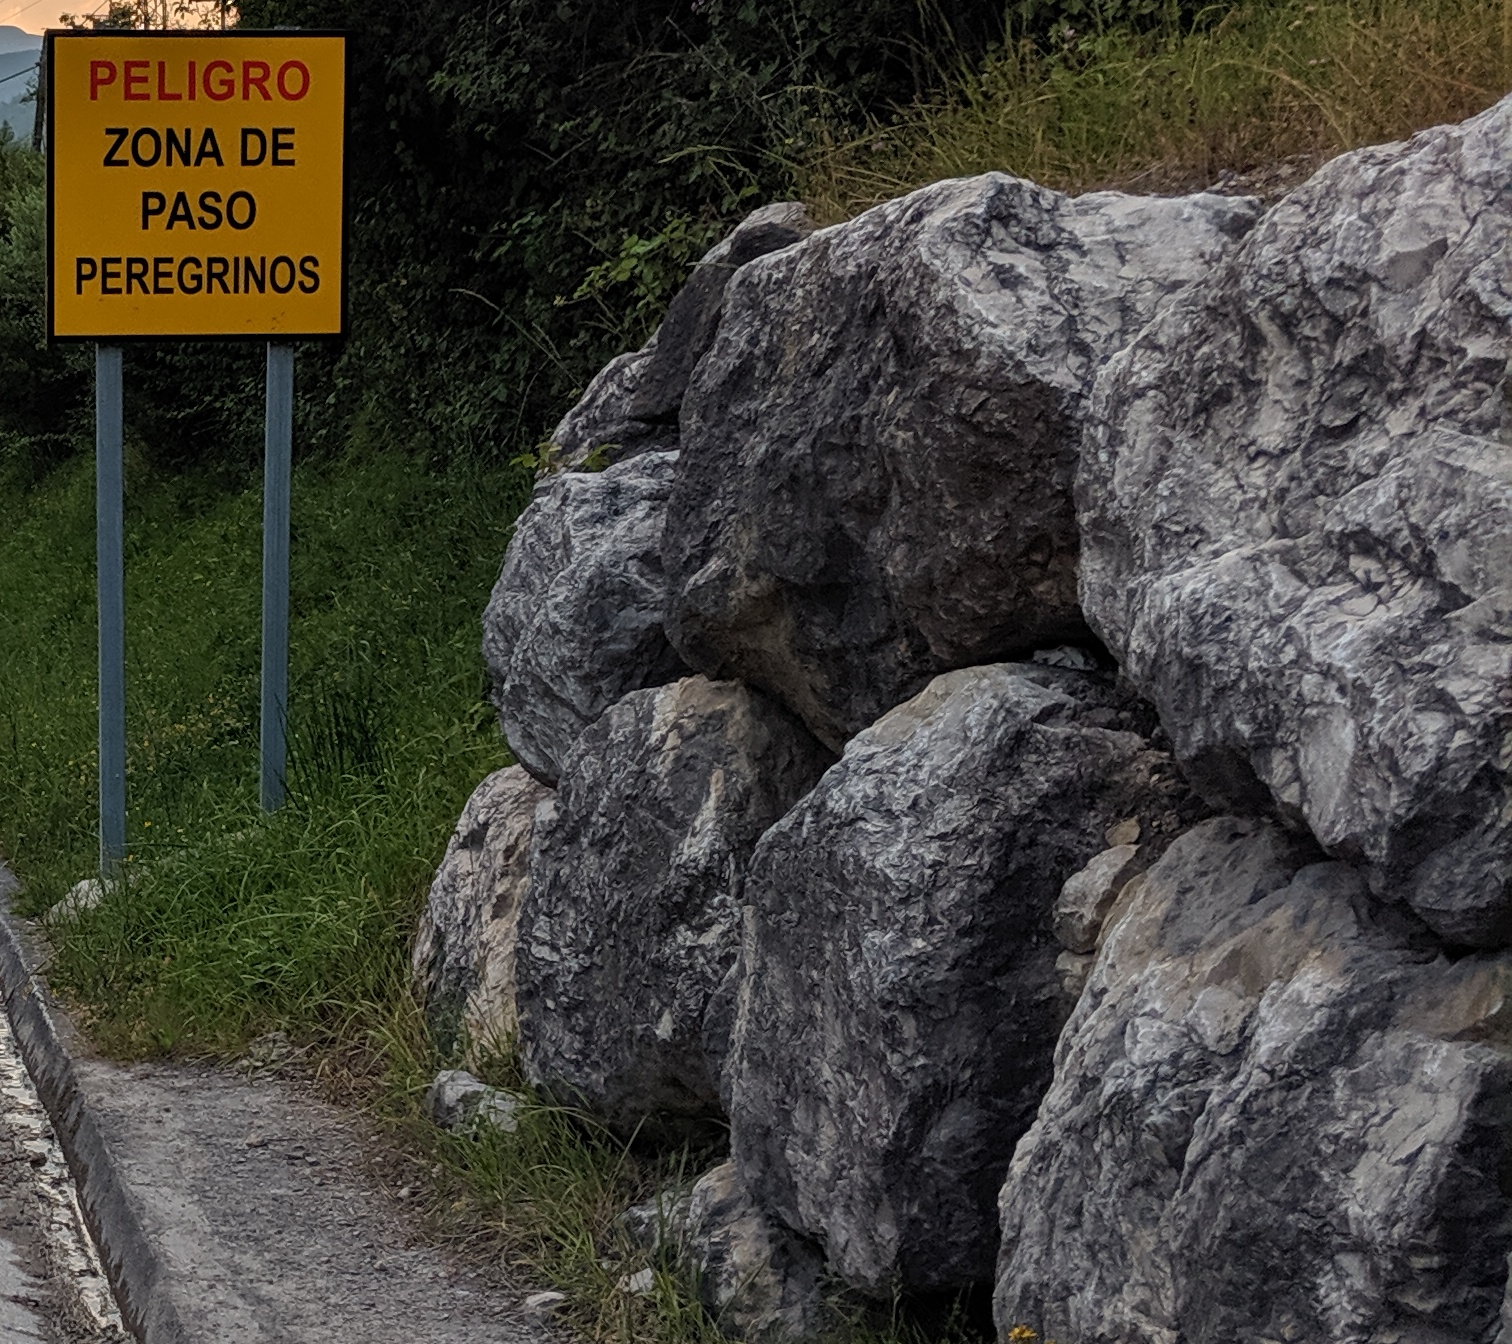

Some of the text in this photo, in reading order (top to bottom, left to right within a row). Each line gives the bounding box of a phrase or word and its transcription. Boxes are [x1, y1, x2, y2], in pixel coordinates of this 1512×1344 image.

[90, 60, 310, 101] PELIGRO
[103, 127, 295, 167] ZONA DE
[142, 191, 256, 230] PASO
[76, 256, 320, 295] PEREGRINOS
